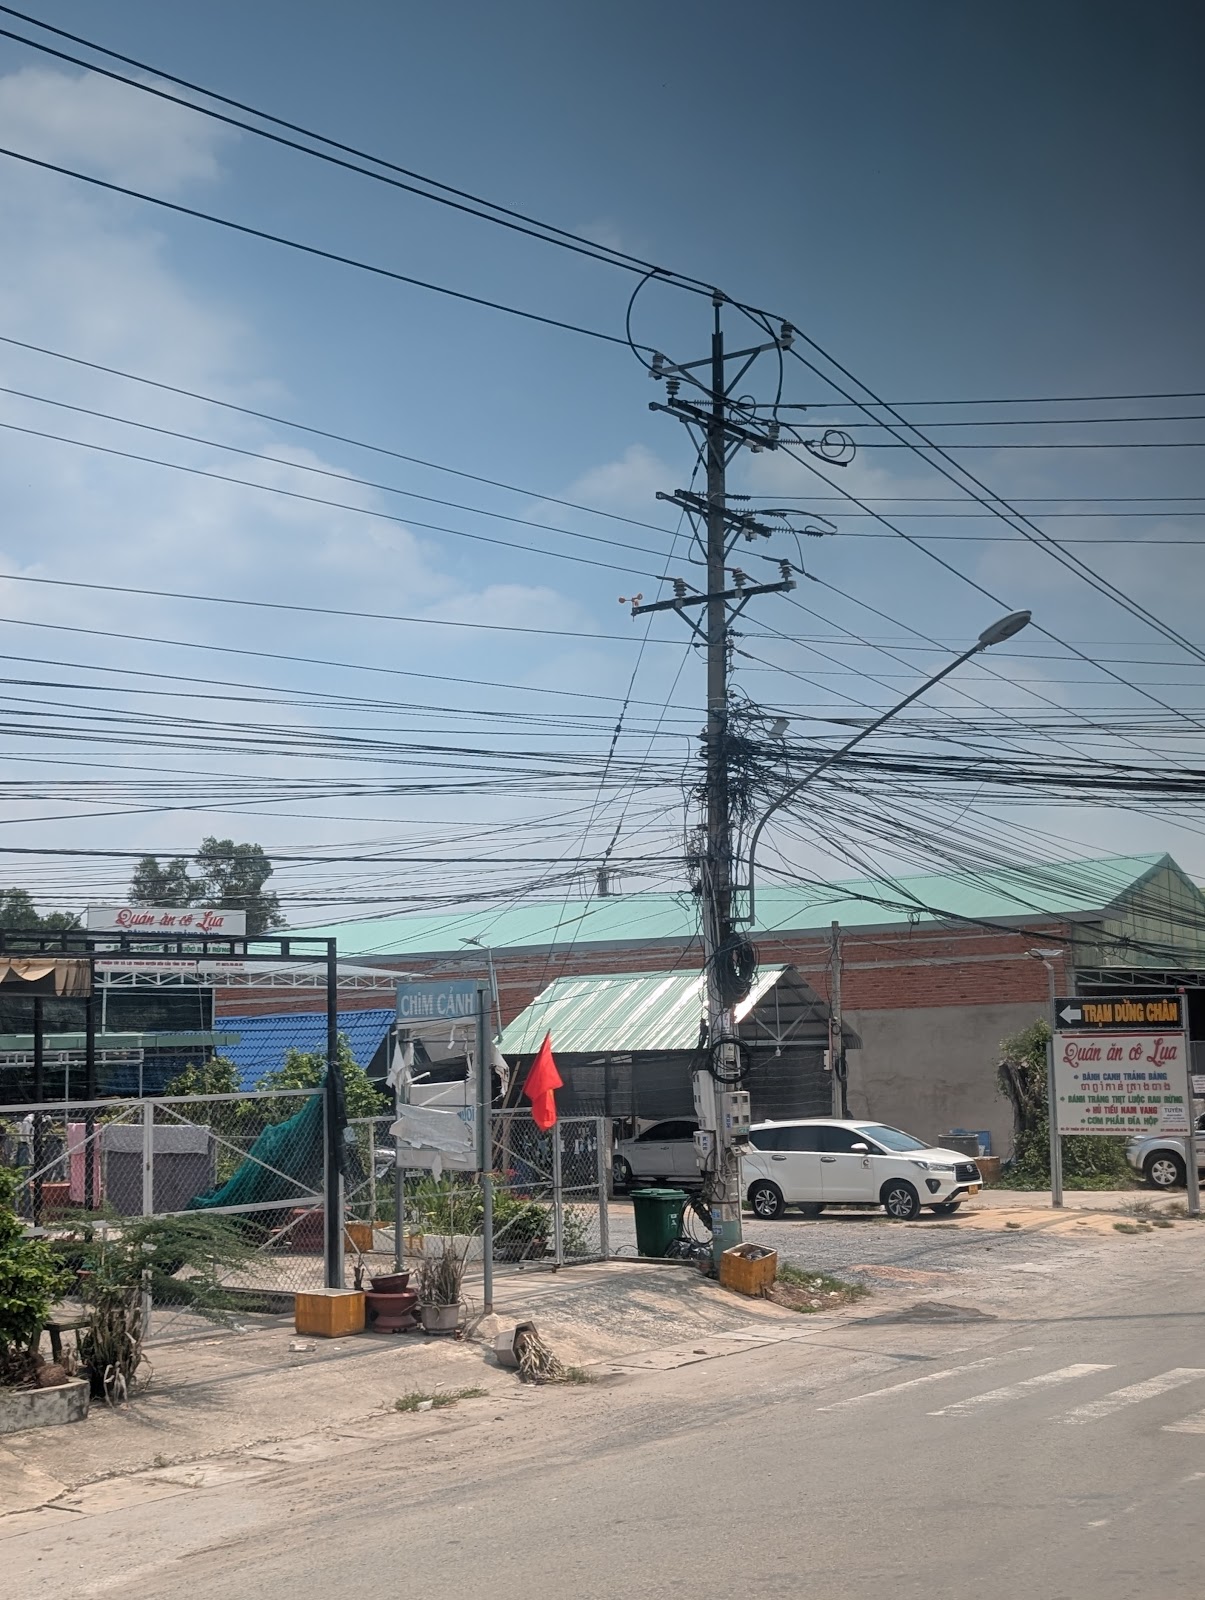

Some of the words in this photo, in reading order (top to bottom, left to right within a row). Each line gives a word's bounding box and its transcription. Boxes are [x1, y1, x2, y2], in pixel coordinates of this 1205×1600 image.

[115, 908, 155, 929] Quán
[179, 914, 193, 926] cô
[437, 986, 473, 1015] CẢNH
[1083, 1004, 1113, 1027] TRẠM
[1115, 998, 1145, 1022] DỪNG
[1146, 999, 1178, 1022] CHÂN
[1063, 1042, 1102, 1068] Quán
[1107, 1043, 1123, 1061] ăn
[1128, 1043, 1144, 1061] cô
[1082, 1071, 1100, 1081] BÁNH
[1103, 1072, 1121, 1081] CANH
[1104, 1104, 1119, 1114] TIẾU
[1121, 1106, 1137, 1114] NAM
[1140, 1106, 1158, 1114] VANG
[1144, 1115, 1159, 1126] HỘP
